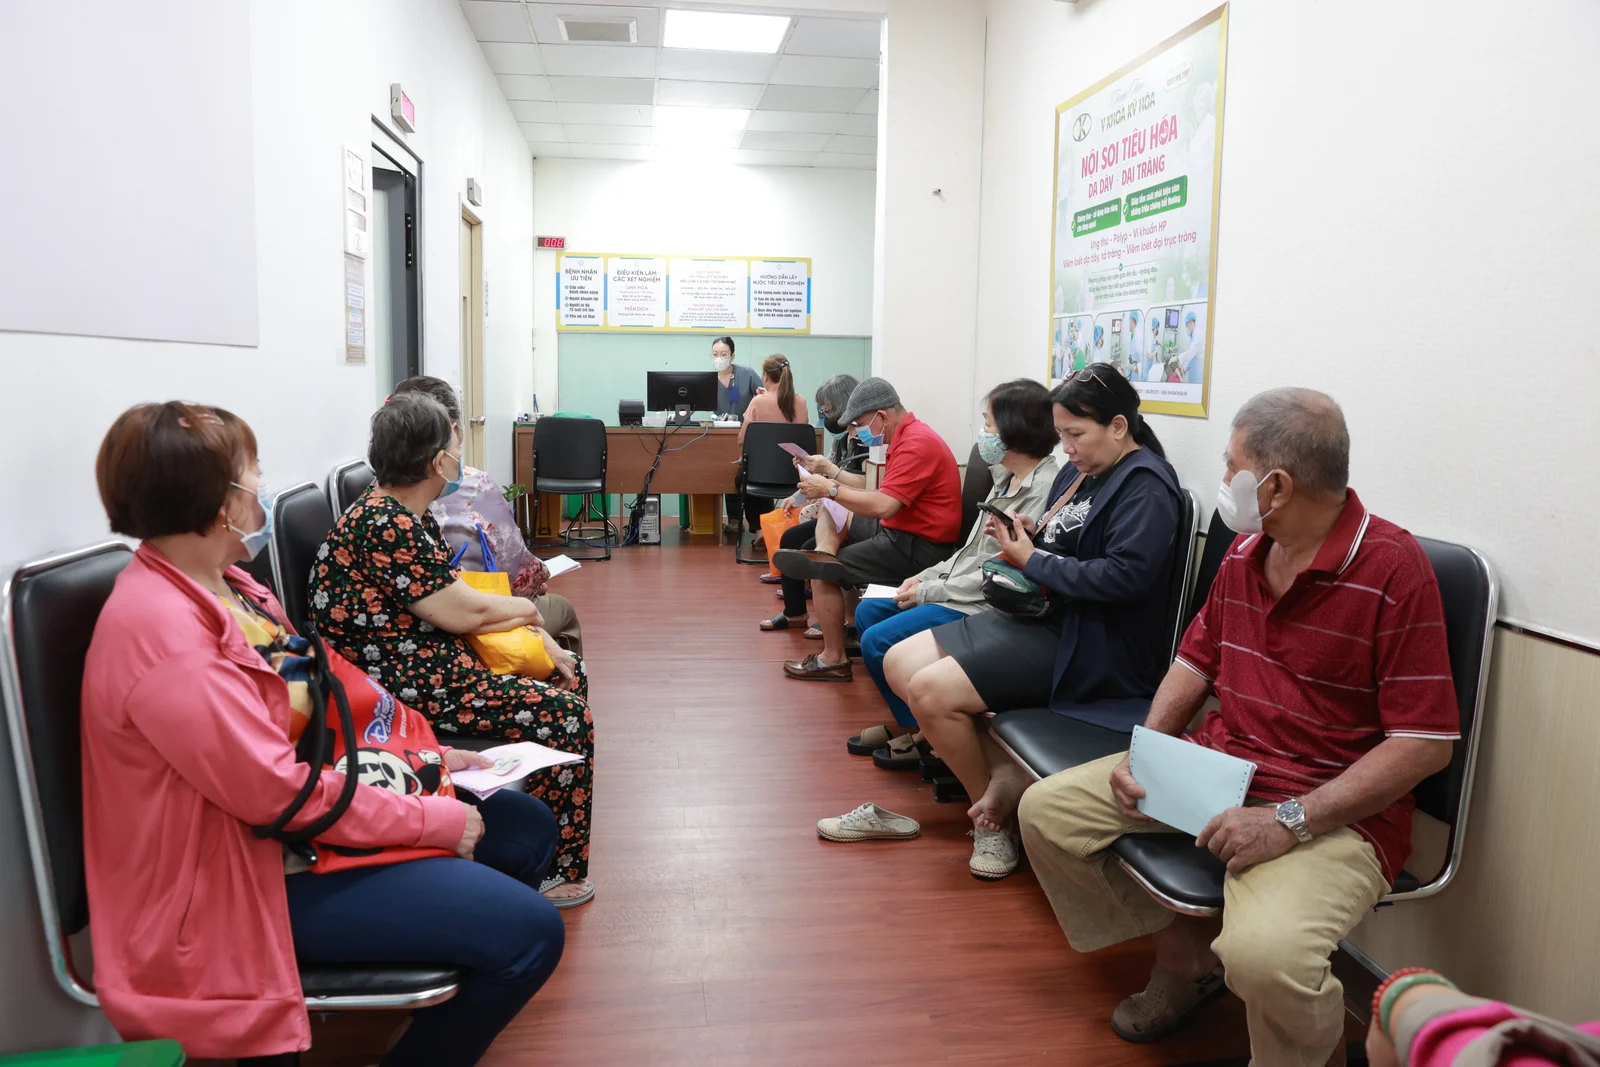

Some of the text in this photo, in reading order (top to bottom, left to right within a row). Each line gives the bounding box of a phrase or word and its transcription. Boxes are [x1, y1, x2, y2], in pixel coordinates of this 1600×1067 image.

[1106, 107, 1126, 130] KHOA
[1081, 113, 1178, 179] NỘI SOI TIÊU HÓA
[1089, 181, 1098, 199] DẠ
[1099, 174, 1114, 195] DÀY
[1122, 165, 1135, 186] ĐẠI
[1137, 153, 1166, 180] TRÀNG
[544, 237, 563, 247] 008
[1113, 232, 1128, 244] Polyp
[1158, 220, 1167, 232] HP
[1126, 244, 1140, 255] Viêm
[1140, 240, 1152, 251] loét
[1178, 230, 1197, 243] tràng
